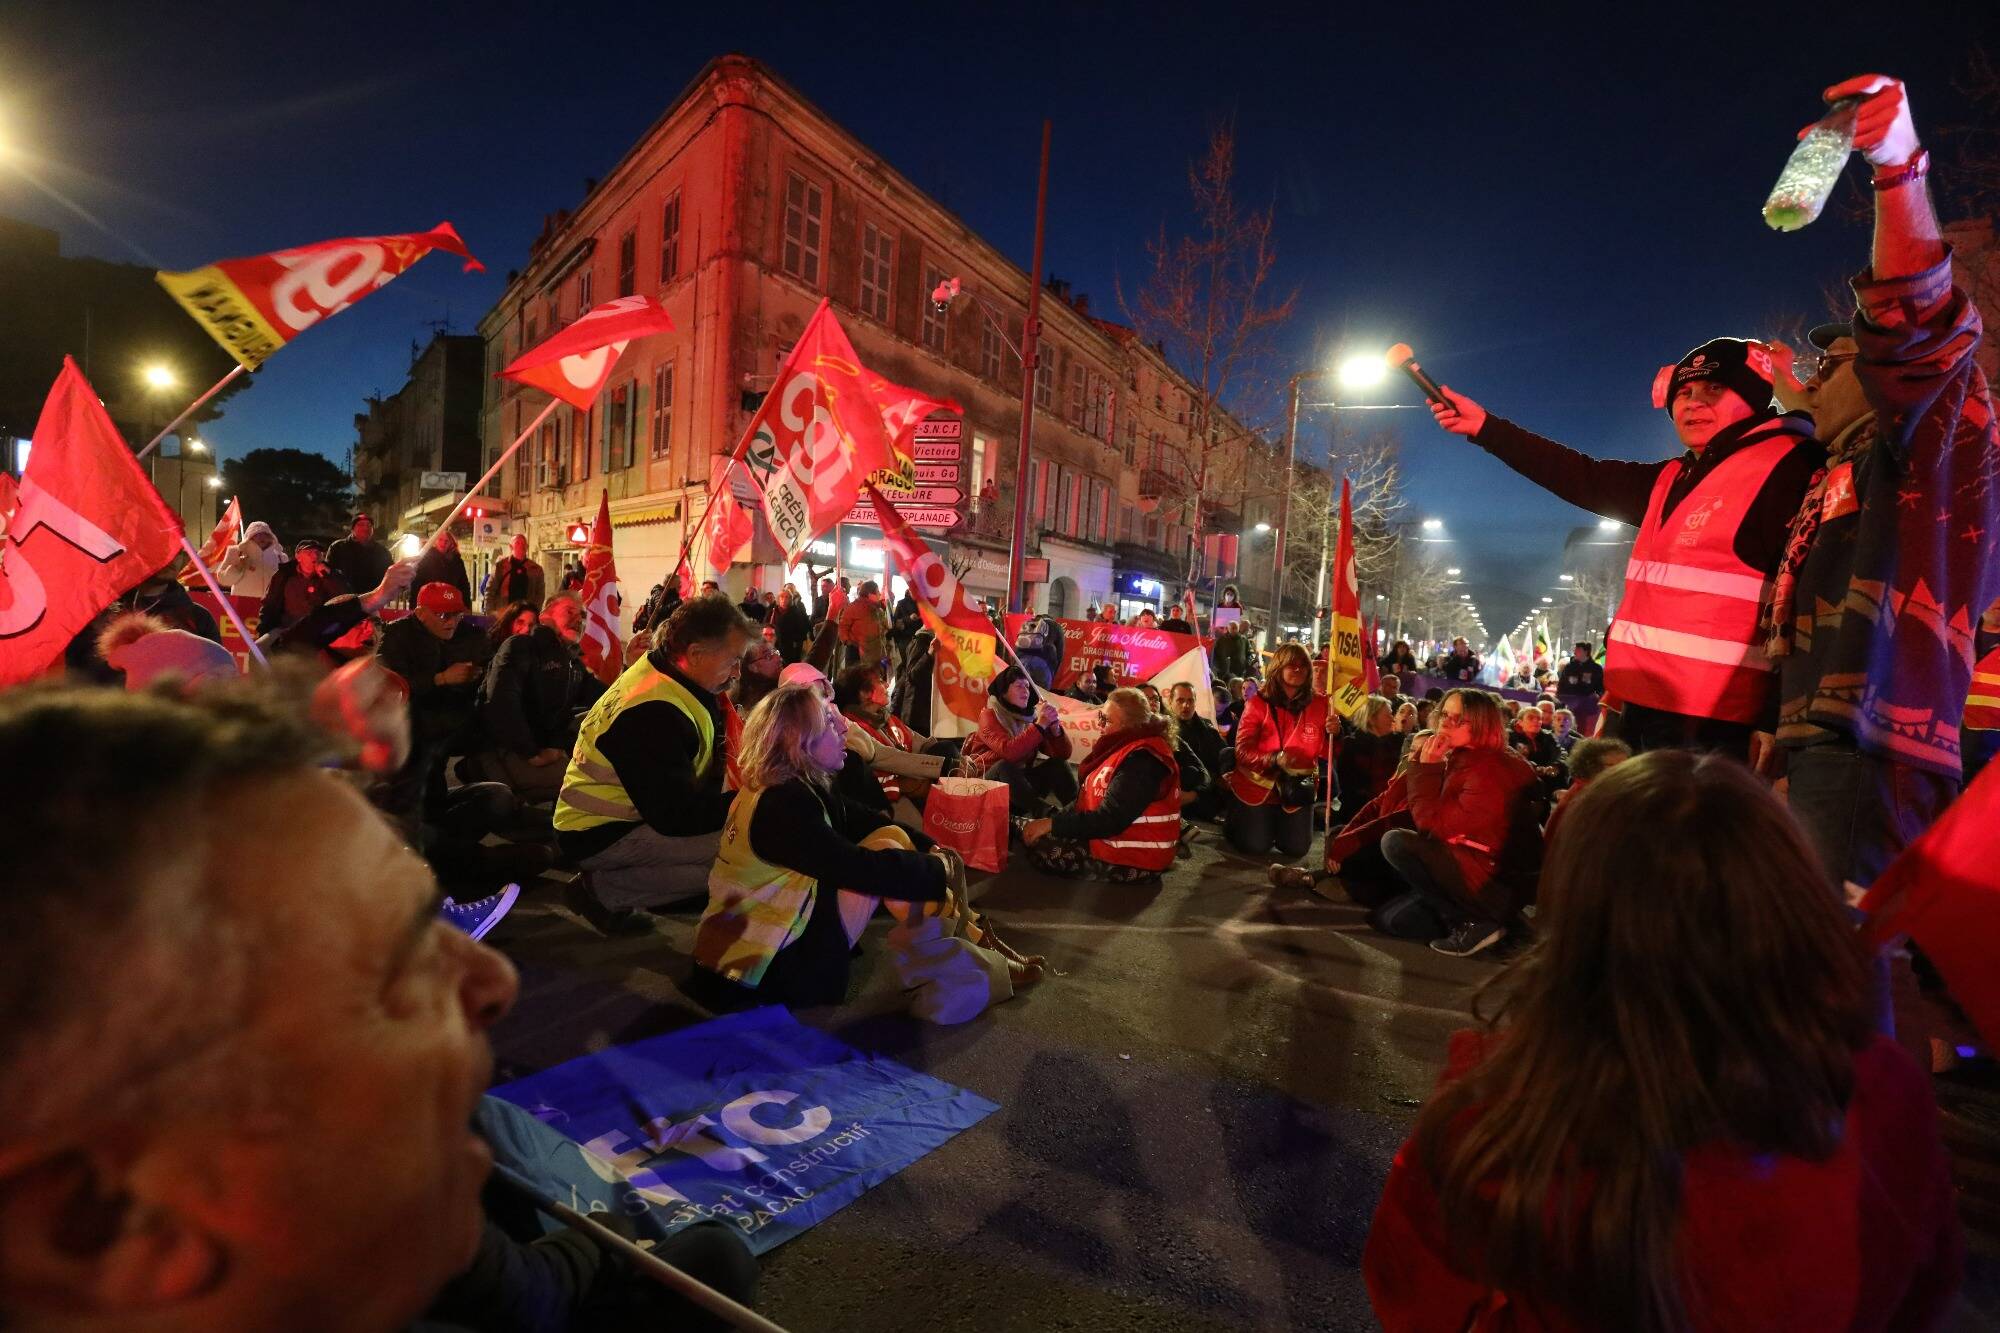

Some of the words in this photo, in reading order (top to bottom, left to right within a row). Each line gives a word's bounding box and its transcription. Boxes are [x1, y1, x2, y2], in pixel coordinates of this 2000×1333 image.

[913, 468, 935, 478] ouis
[1089, 627, 1120, 647] Jean
[1120, 631, 1169, 650] Moulin
[1083, 646, 1130, 659] DRAGUIGNAN
[1071, 656, 1089, 672] EN
[743, 1121, 871, 1198] constructif
